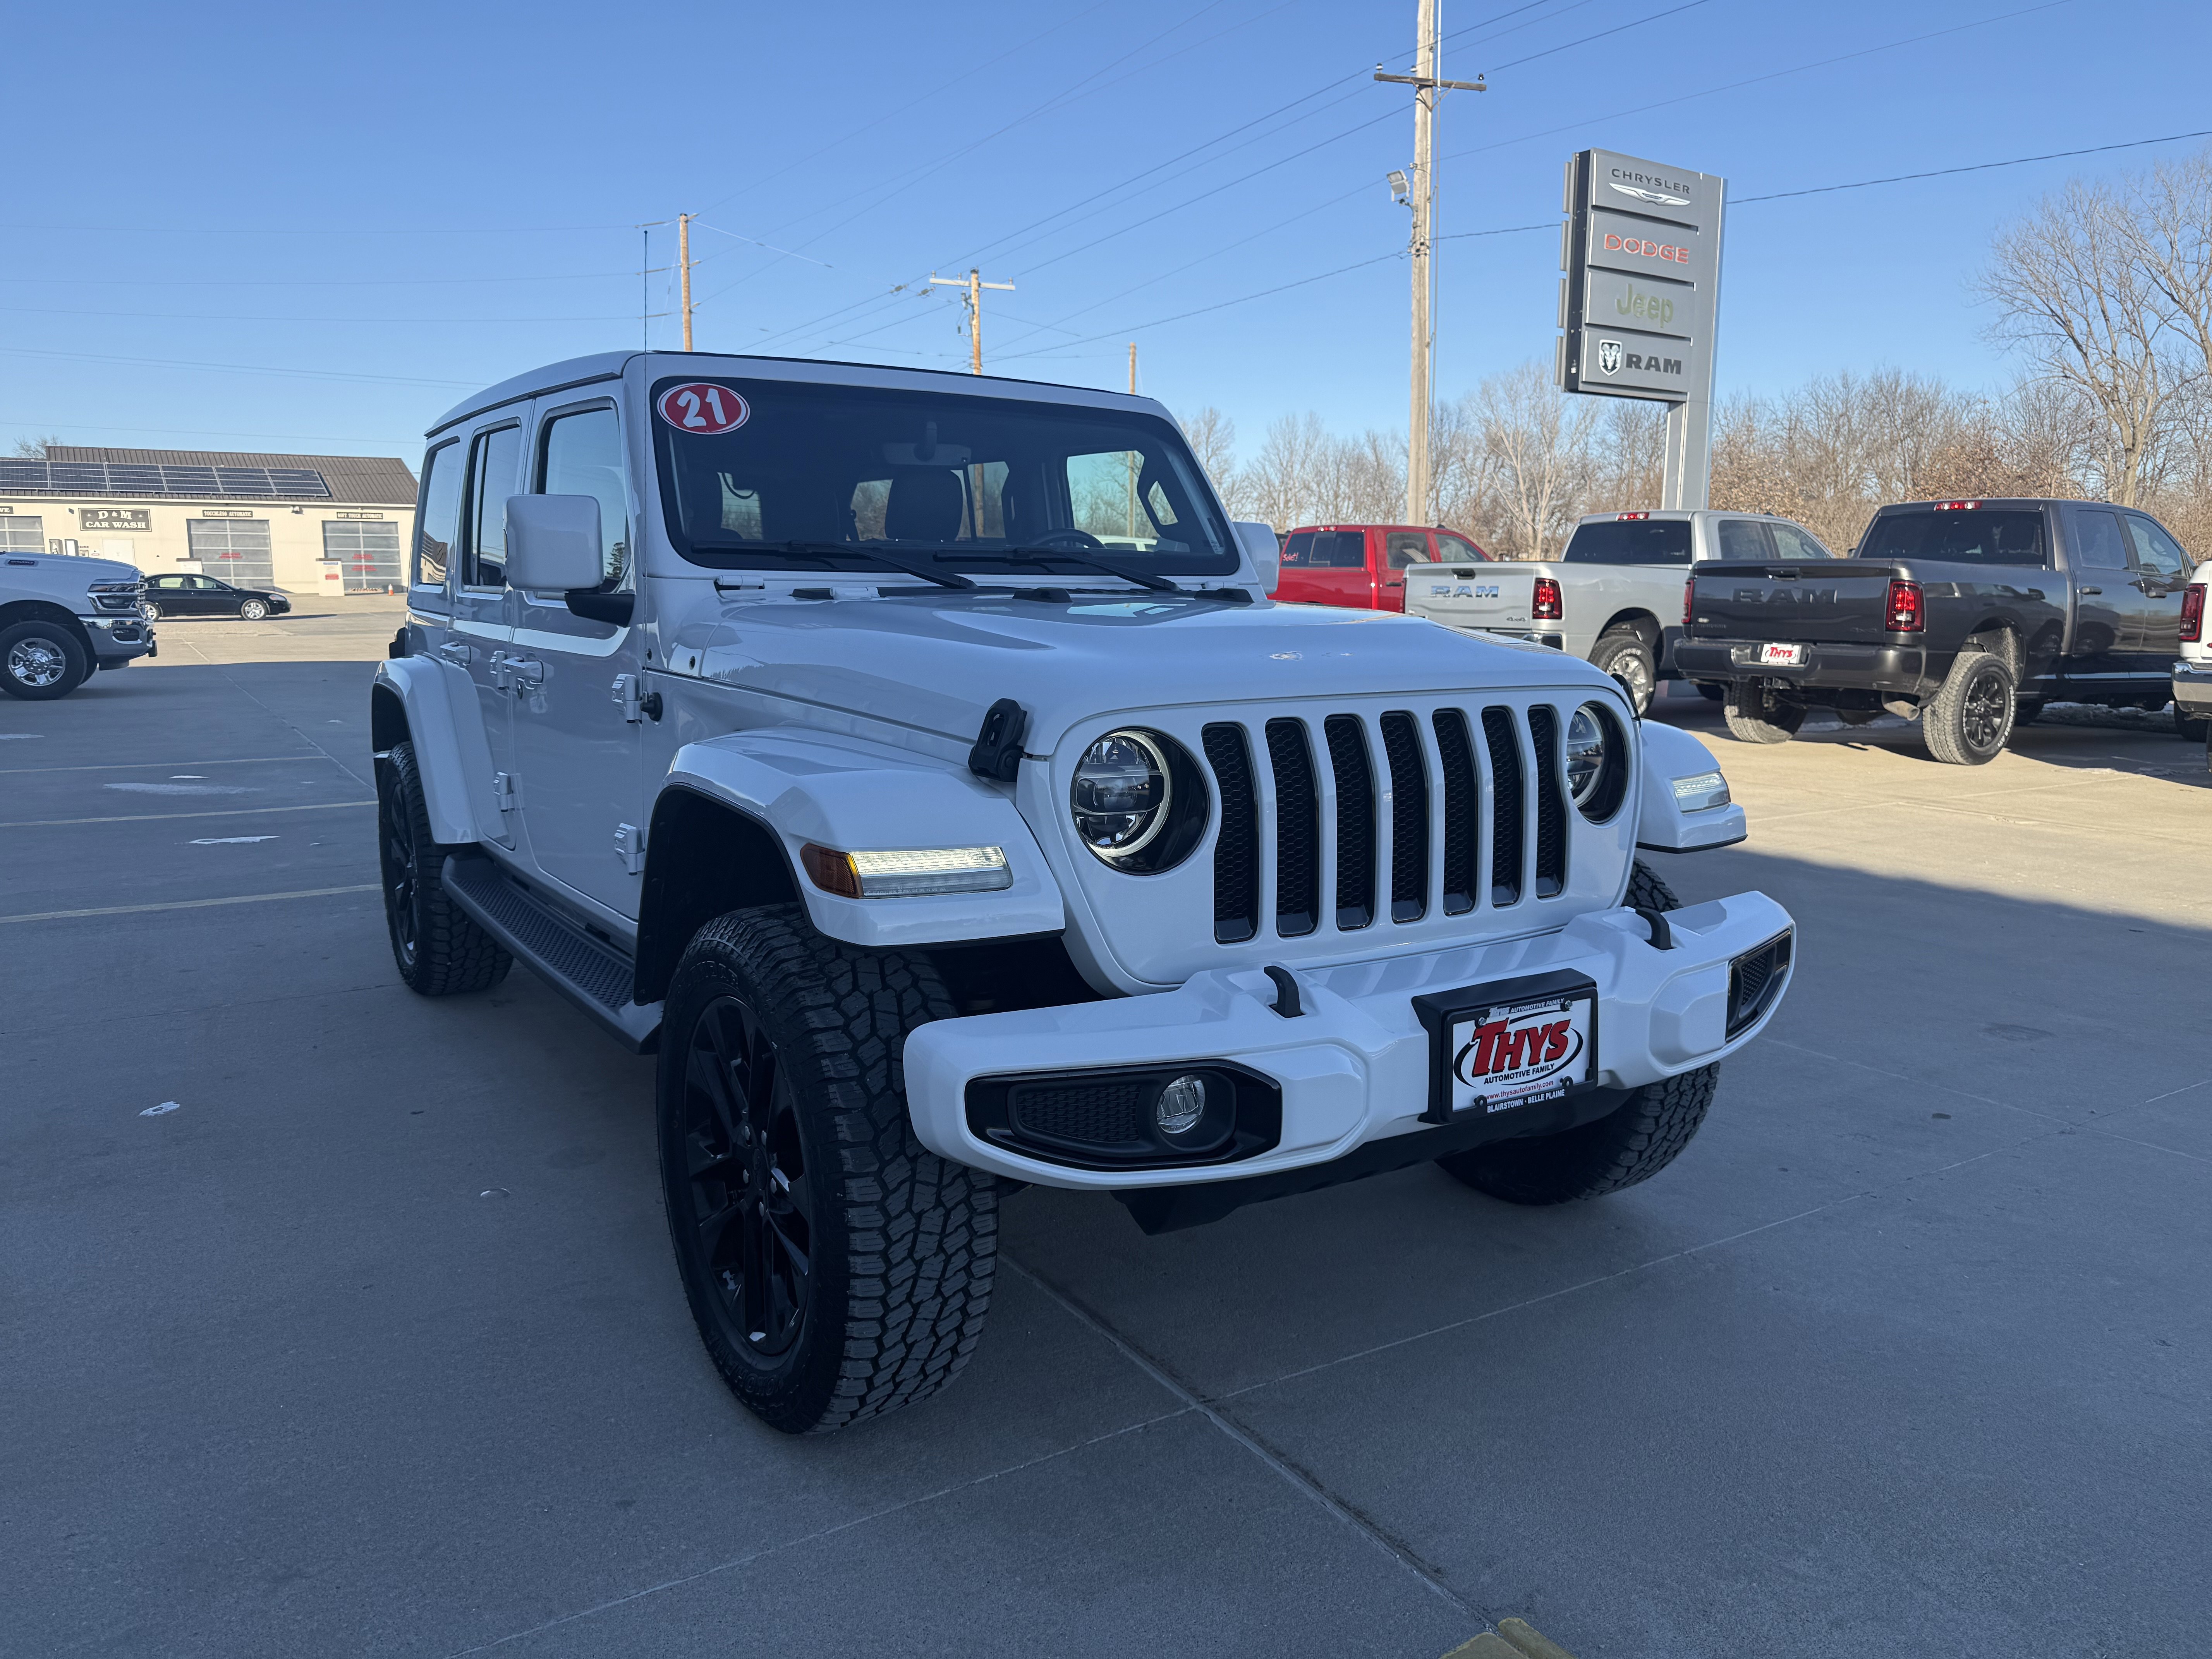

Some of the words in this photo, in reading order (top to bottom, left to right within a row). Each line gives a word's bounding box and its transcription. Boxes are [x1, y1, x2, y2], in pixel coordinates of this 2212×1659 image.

[1611, 168, 1690, 194] CHRYSLER
[1604, 234, 1689, 264] DODGE
[1615, 283, 1673, 328] Jeep
[1625, 353, 1681, 375] RAM
[677, 388, 727, 428] 21
[98, 510, 108, 519] D
[120, 510, 132, 520] M
[1430, 586, 1499, 598] RAM
[1732, 588, 1838, 604] RAM
[1769, 647, 1793, 658] THYS
[1510, 1002, 1545, 1013] AUTOMOTIVE
[1546, 998, 1565, 1006] FAMILY
[1471, 1017, 1571, 1078] THYS
[1484, 1069, 1530, 1085] AUTOMOTIVE
[1532, 1063, 1554, 1075] FAMILY
[1486, 1080, 1554, 1099] www.thysautofamily.com
[1487, 1098, 1523, 1113] BLAIRSTOWN
[1527, 1093, 1545, 1104] BELLE
[1546, 1089, 1565, 1100] PLAINE
